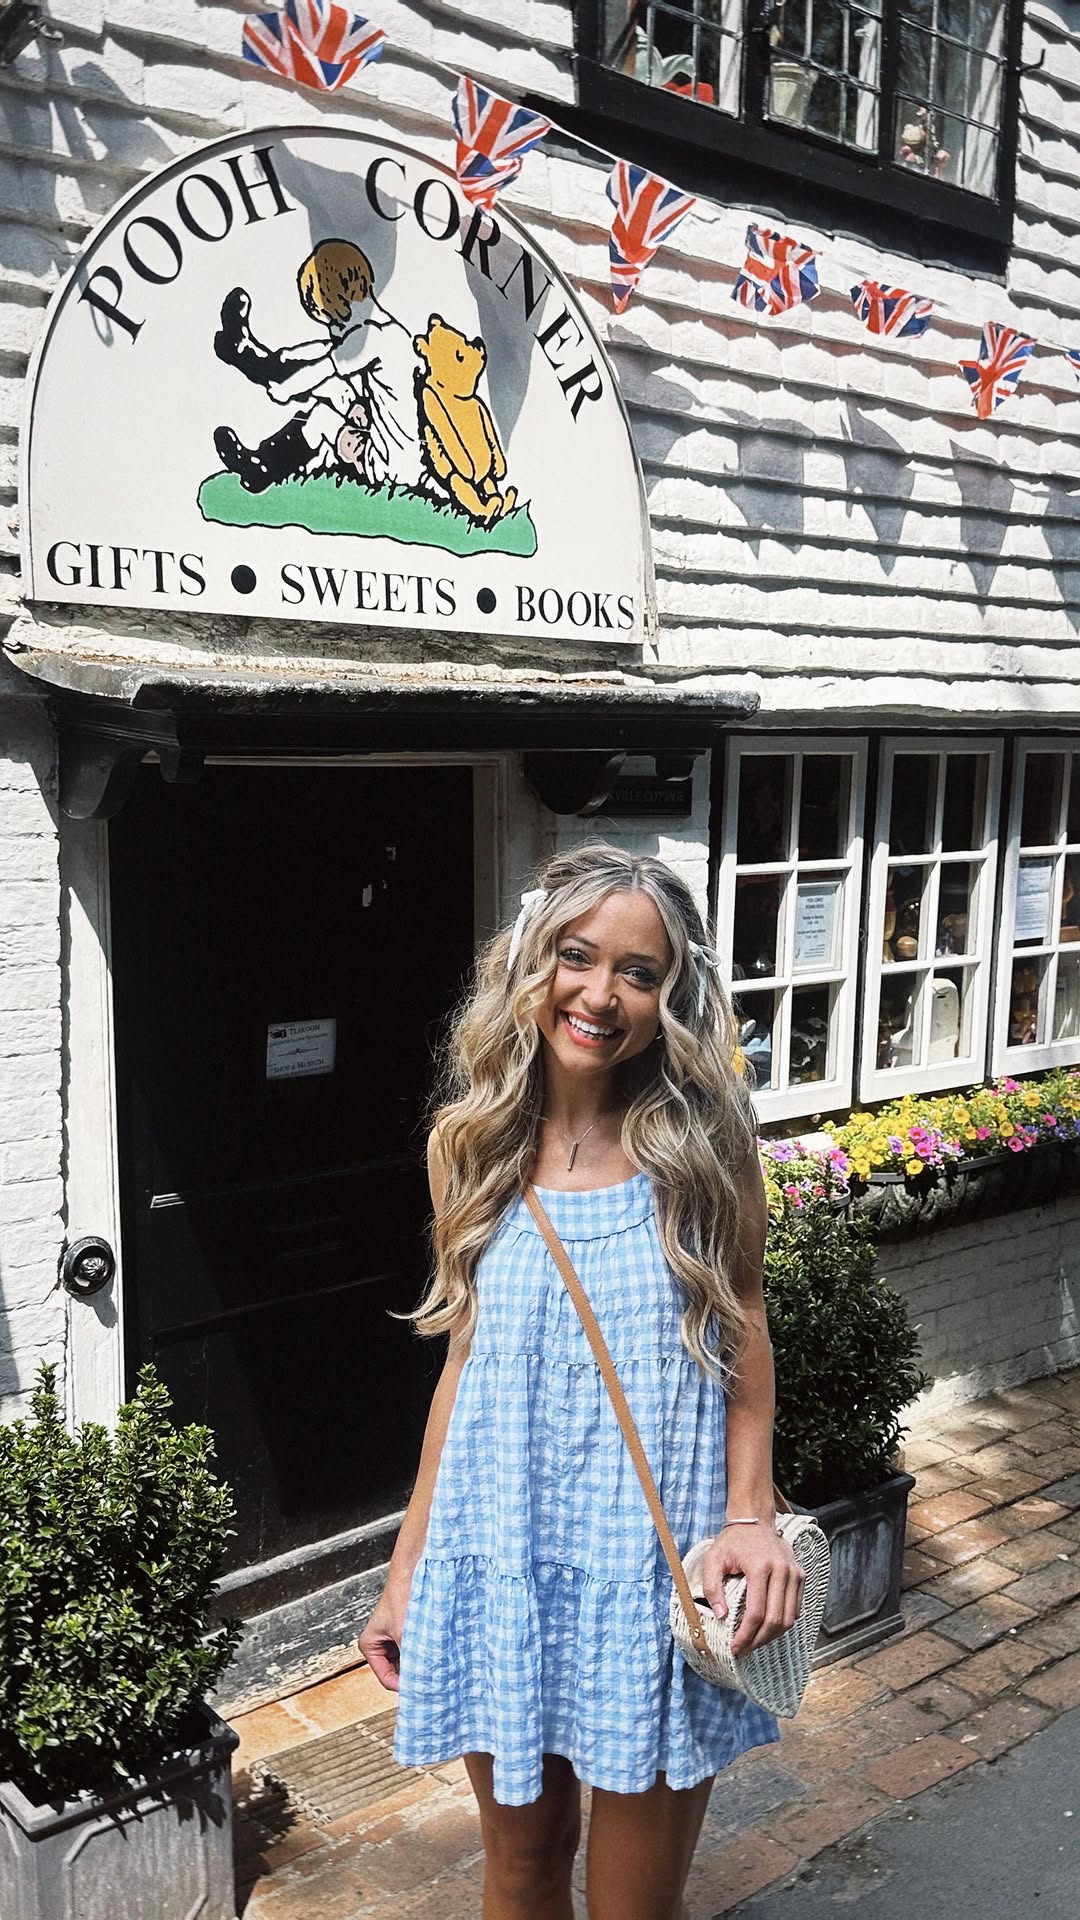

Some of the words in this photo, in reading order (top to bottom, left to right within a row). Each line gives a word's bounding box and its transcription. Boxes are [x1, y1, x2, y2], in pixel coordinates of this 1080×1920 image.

[80, 146, 297, 345] POOH
[365, 157, 604, 422] CORNER
[46, 541, 206, 597] GIFTS
[280, 564, 456, 617] SWEETS
[516, 585, 635, 630] BOOKS
